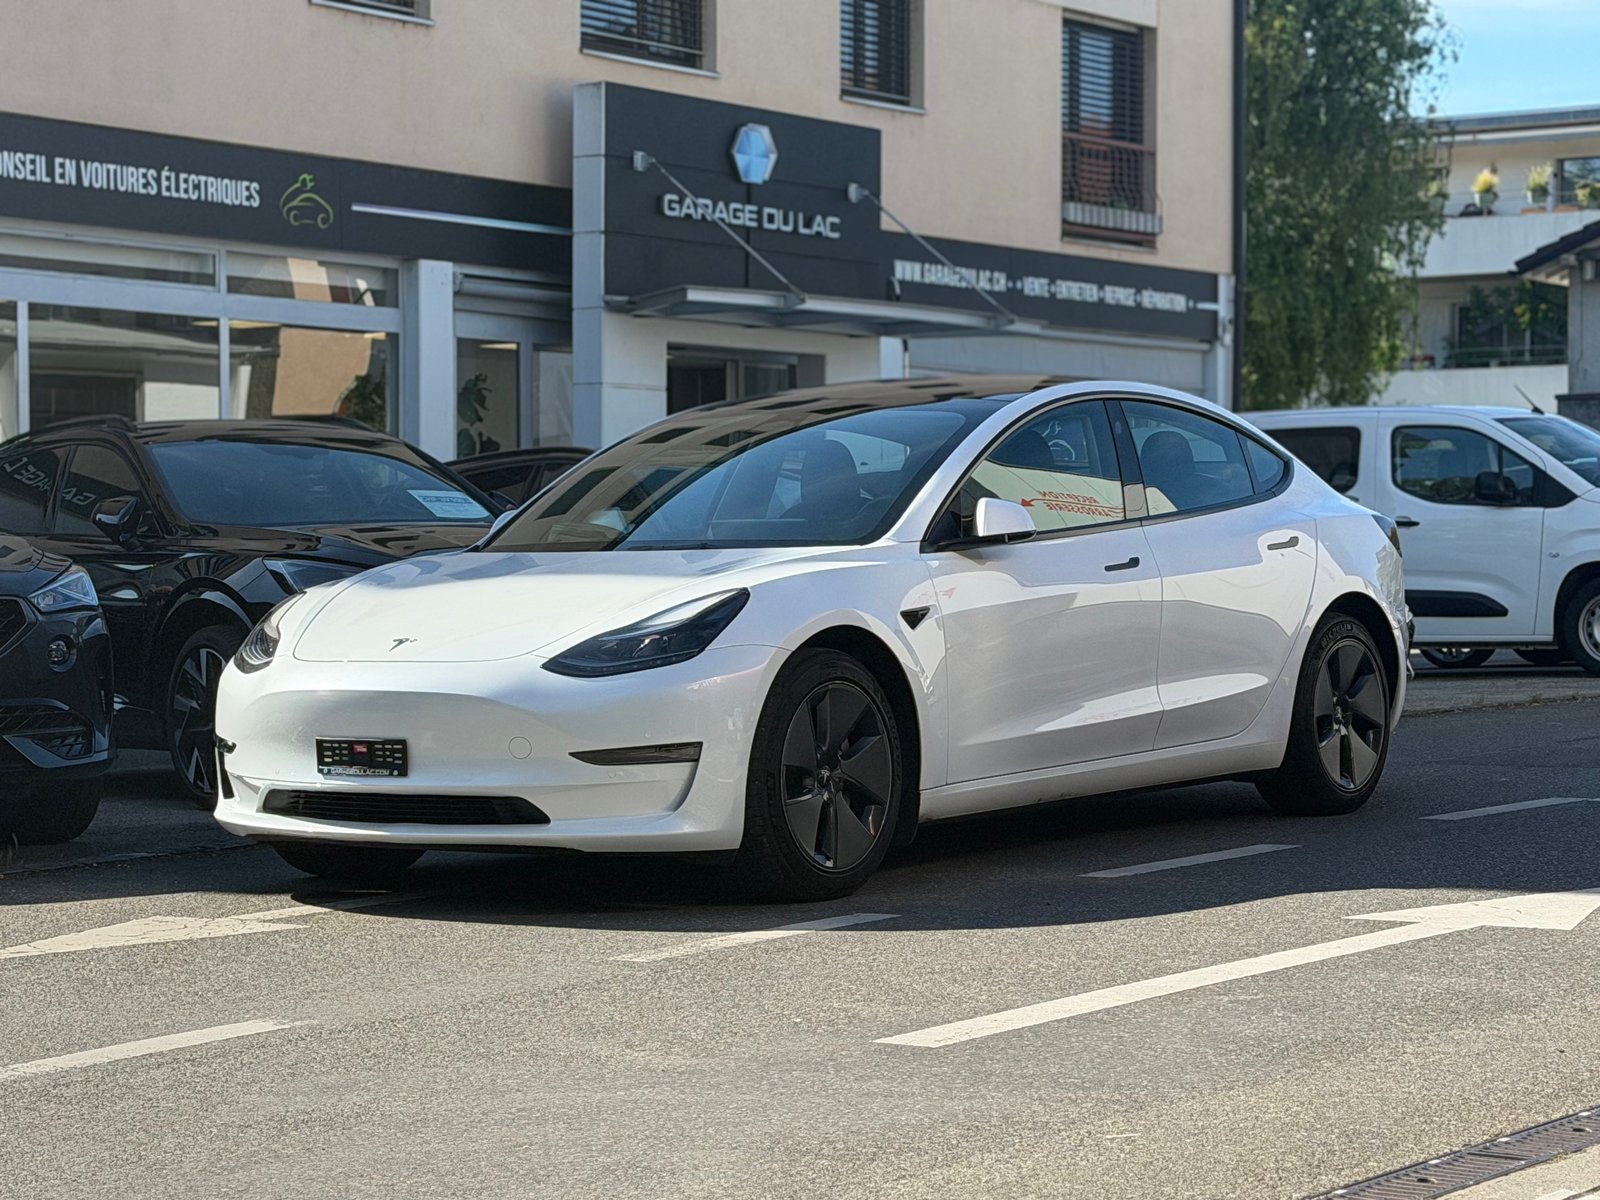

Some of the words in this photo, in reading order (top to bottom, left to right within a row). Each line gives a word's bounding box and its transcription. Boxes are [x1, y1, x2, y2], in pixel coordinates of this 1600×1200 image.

[54, 157, 77, 186] EN
[80, 160, 158, 196] VOITURES
[161, 166, 260, 208] ÉLECTRIQUES
[663, 193, 759, 228] GARAGE
[762, 206, 794, 232] DU
[798, 212, 841, 239] LAC
